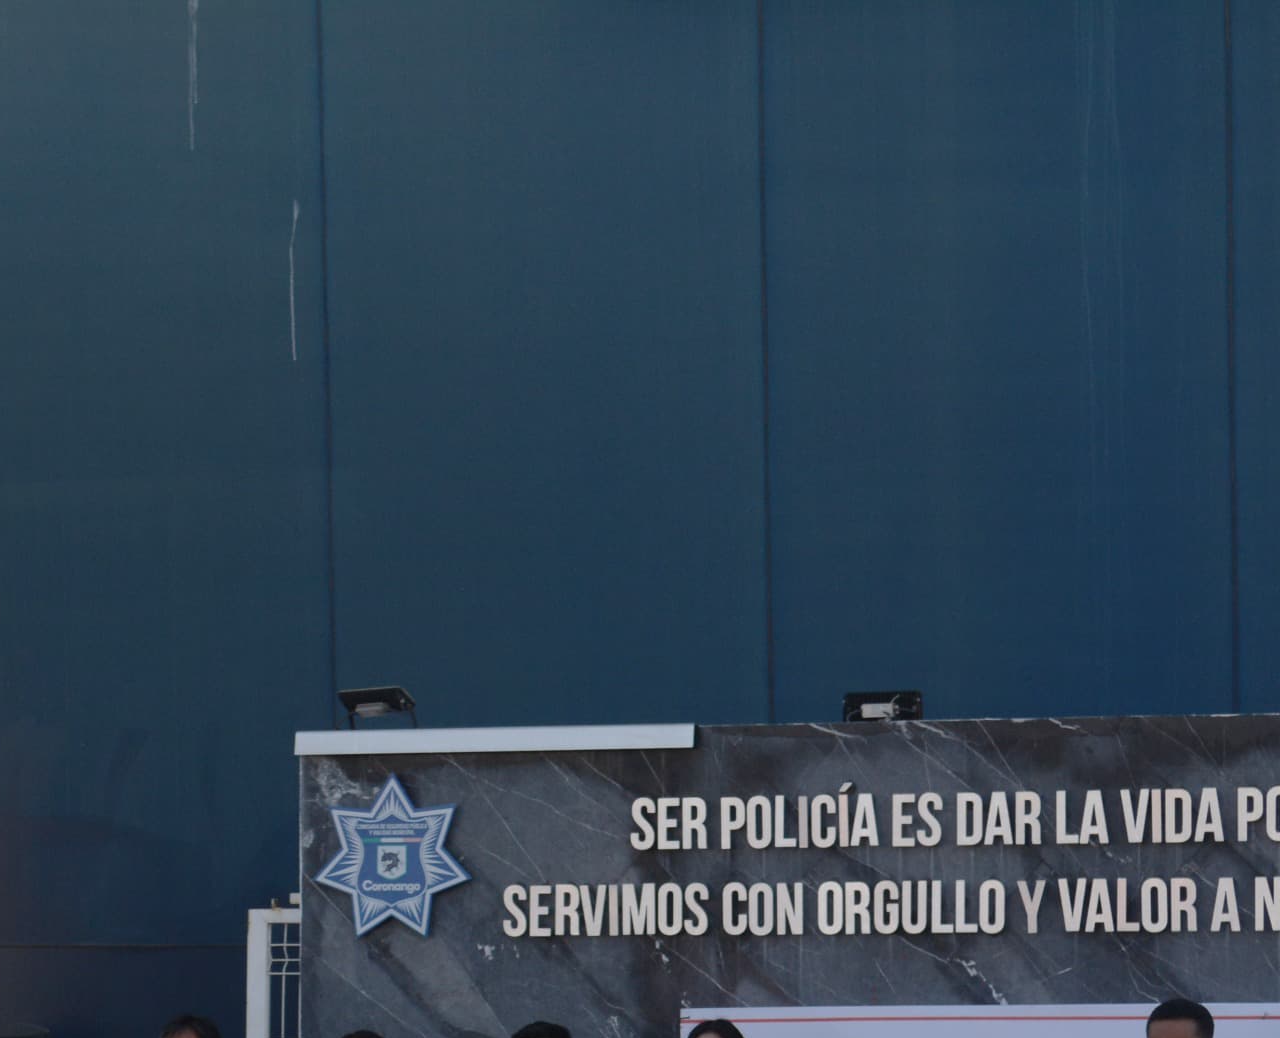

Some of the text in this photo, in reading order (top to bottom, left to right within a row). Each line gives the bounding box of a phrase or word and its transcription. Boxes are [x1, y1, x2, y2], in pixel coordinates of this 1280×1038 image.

[629, 781, 1280, 851] SER POLICÍA ES DAR LA VIDA PO
[362, 879, 421, 894] Coronango
[502, 875, 1280, 938] SERVIMOS CON ORGULLO Y VALOR A N
